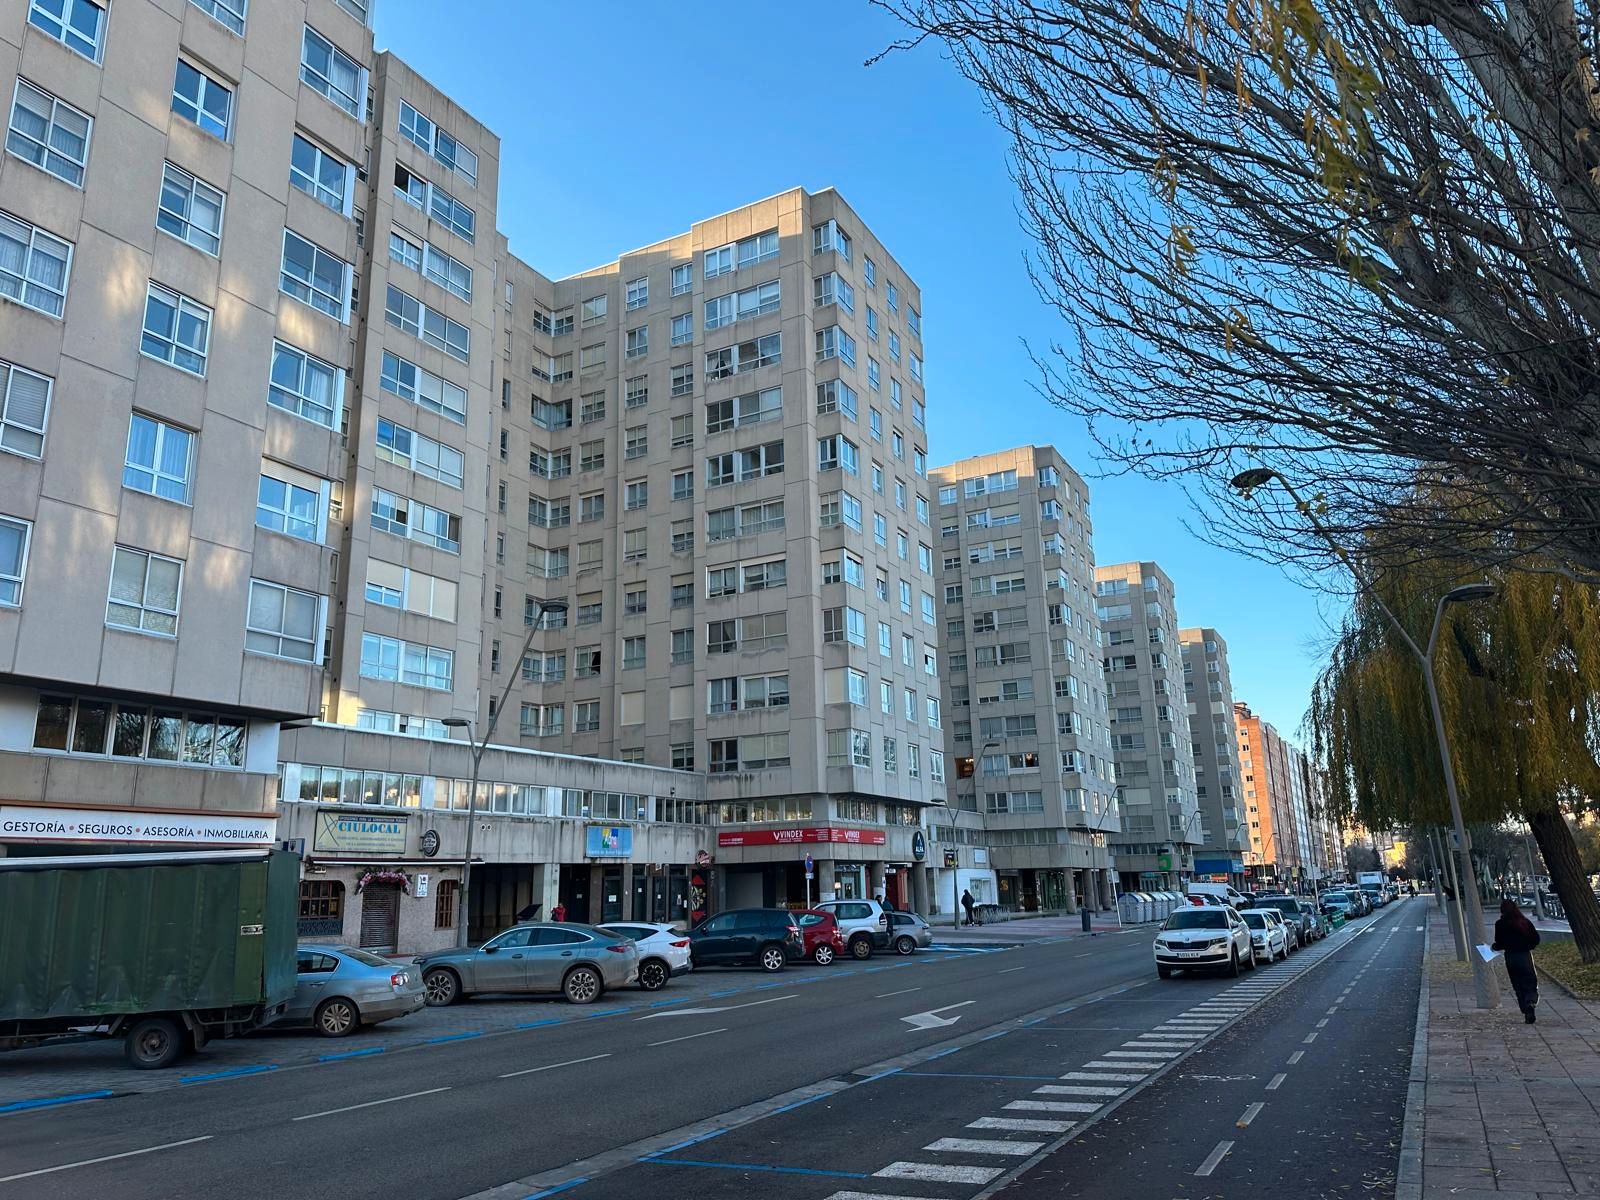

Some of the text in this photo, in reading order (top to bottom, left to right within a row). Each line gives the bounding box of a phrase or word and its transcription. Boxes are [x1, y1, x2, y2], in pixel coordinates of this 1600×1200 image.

[3, 820, 269, 839] GESTORÍA SEGUROS ASESORÍA INMOBILIARIA
[338, 822, 401, 834] CIULOCAL
